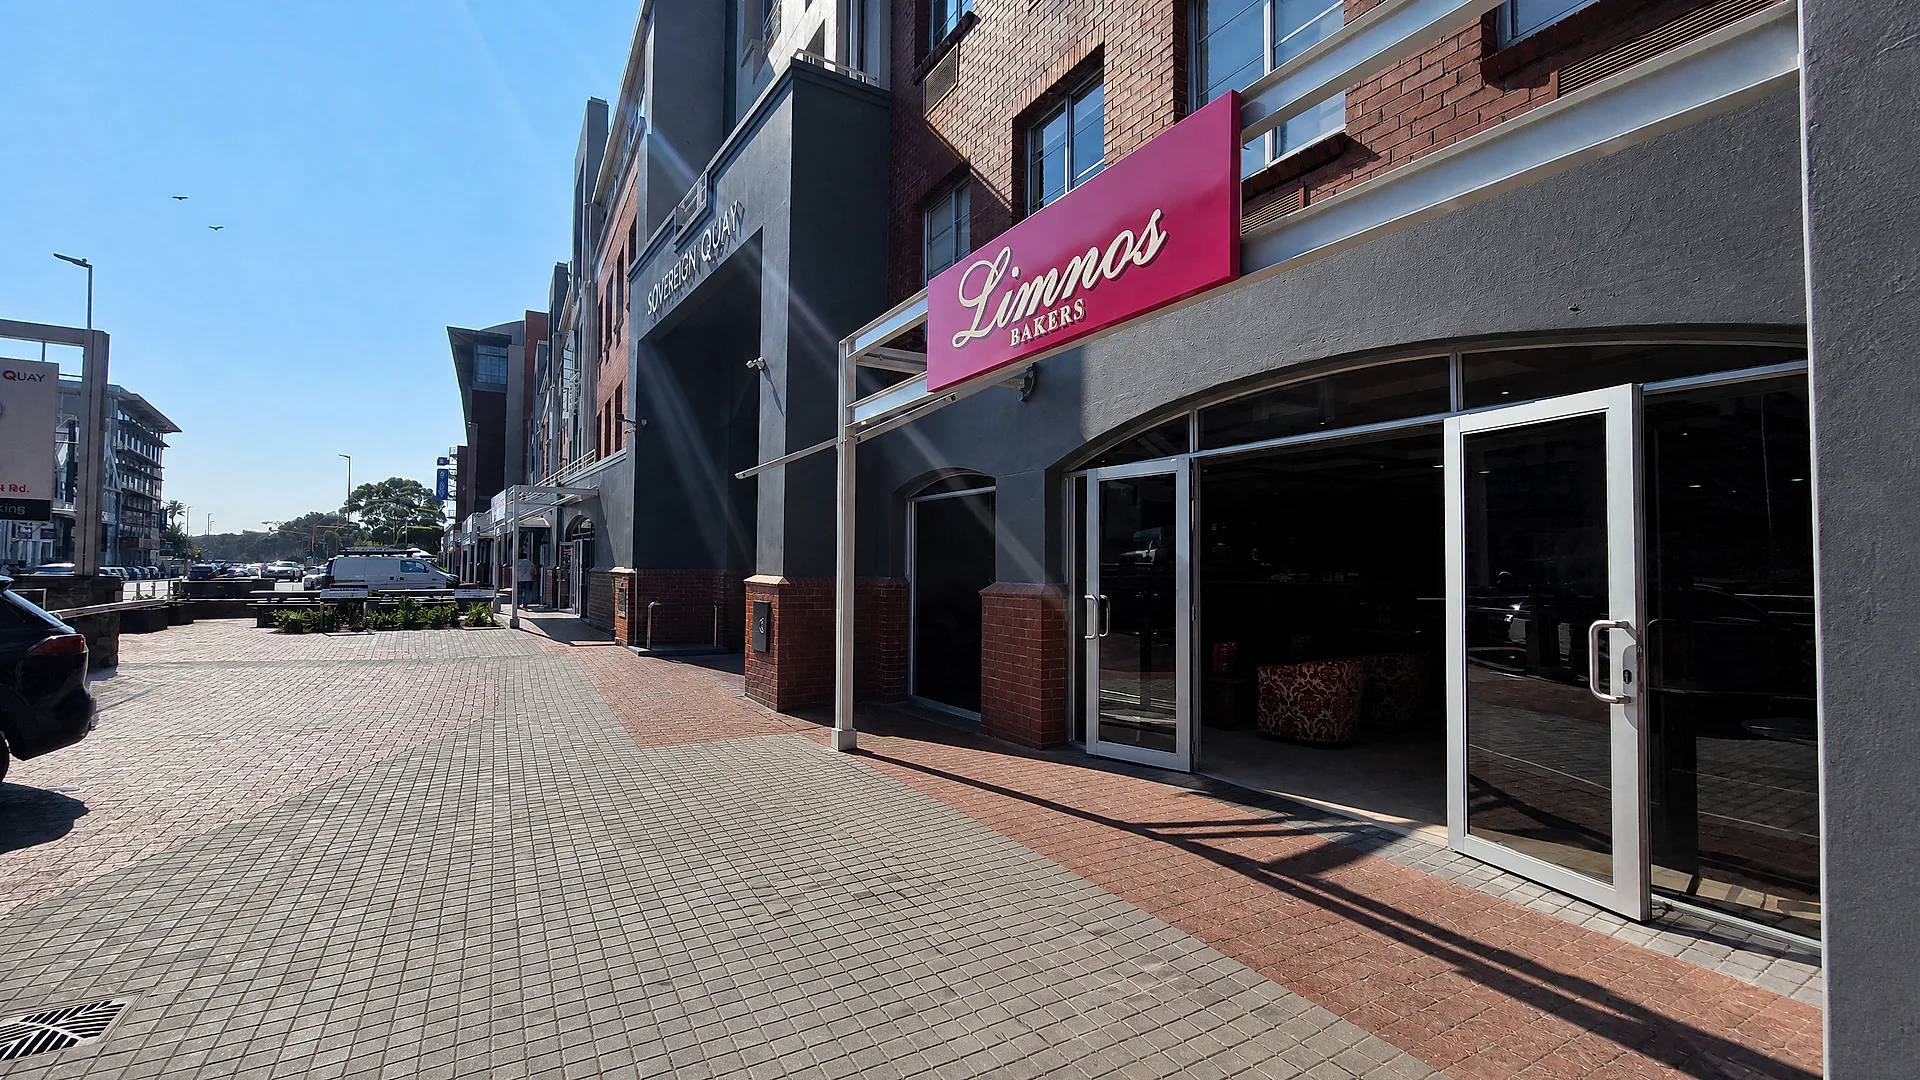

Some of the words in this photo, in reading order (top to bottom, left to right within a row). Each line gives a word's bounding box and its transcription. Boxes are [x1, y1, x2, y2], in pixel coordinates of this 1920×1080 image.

[647, 245, 697, 315] SOVEREIGN
[701, 200, 738, 263] QUAY
[952, 208, 1167, 348] Limnos
[1010, 298, 1085, 347] BAKERS
[2, 369, 46, 382] QUAY
[8, 483, 30, 493] Rd.
